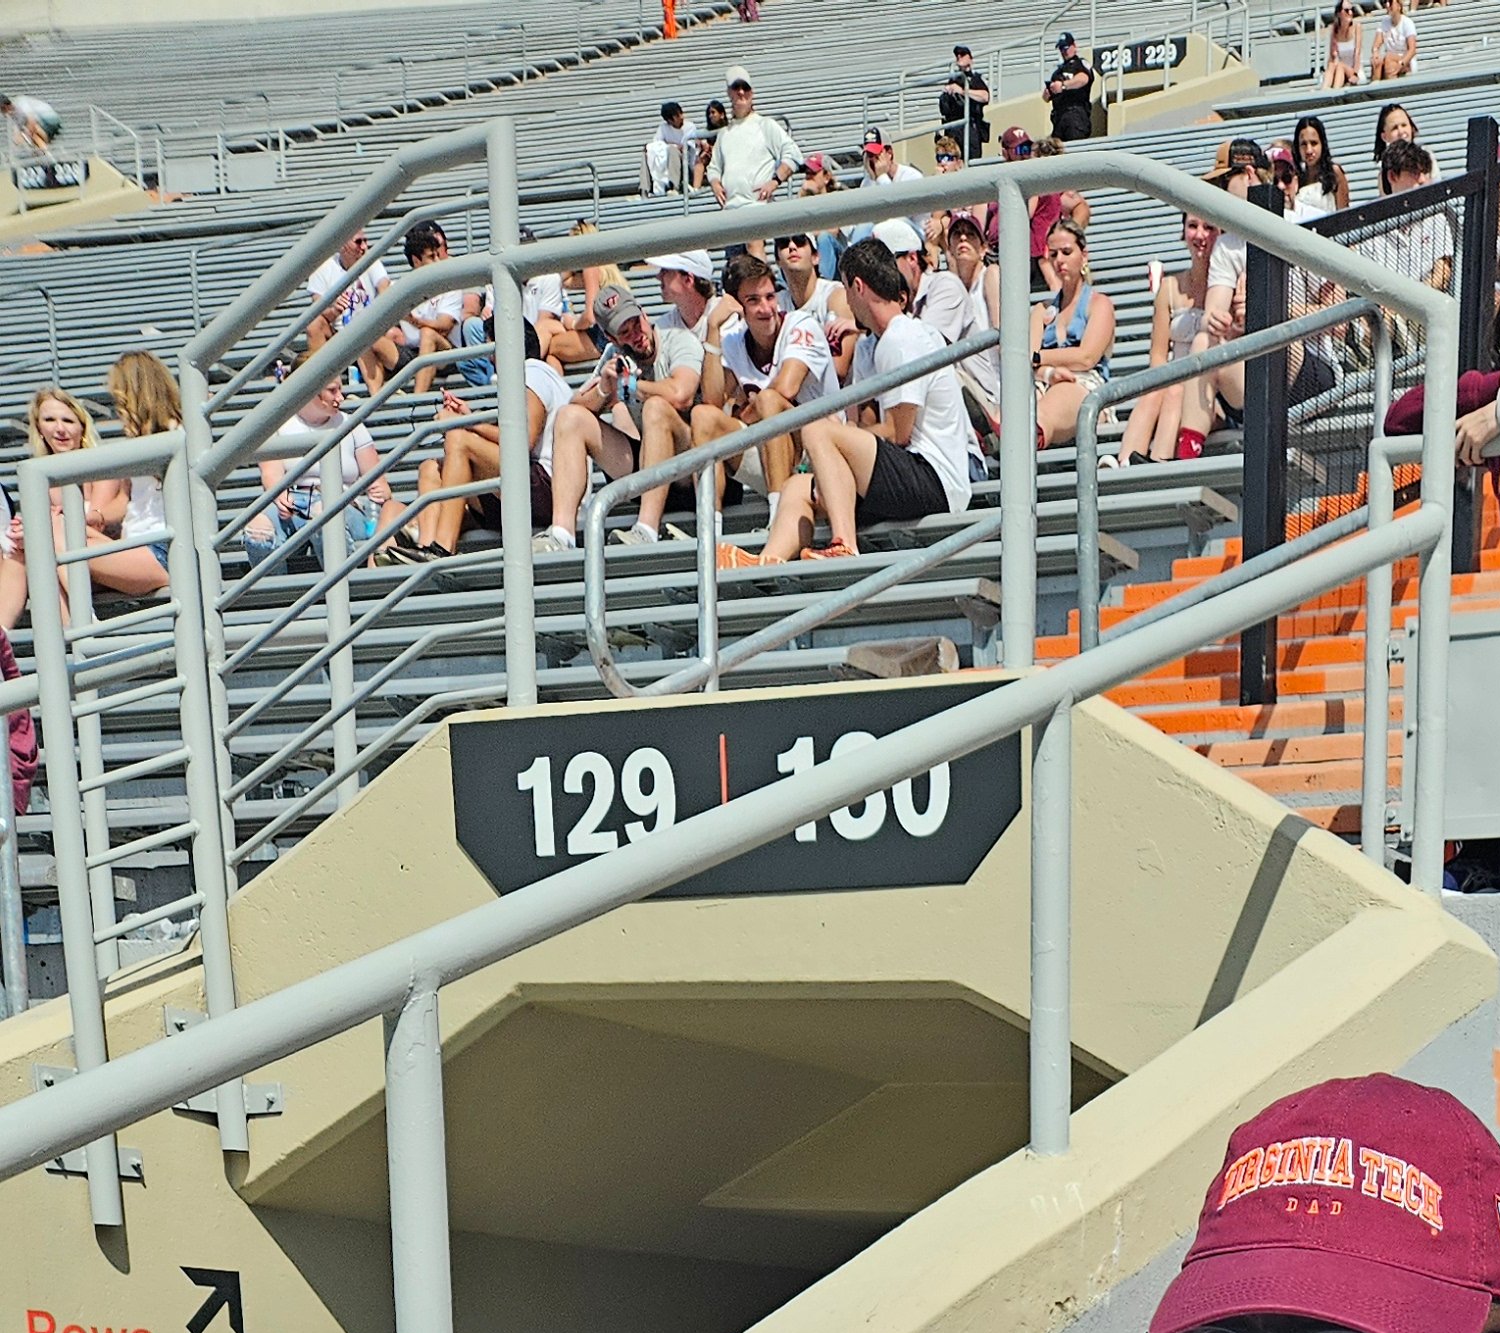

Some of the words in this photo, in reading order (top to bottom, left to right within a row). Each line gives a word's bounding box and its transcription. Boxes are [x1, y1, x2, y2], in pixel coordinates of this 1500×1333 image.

[1101, 48, 1132, 71] 228
[1145, 43, 1177, 65] 229
[517, 747, 677, 857] 129
[1217, 1136, 1355, 1212] VIRGINIA
[1360, 1146, 1444, 1231] TECH
[1285, 1197, 1343, 1216] DAD
